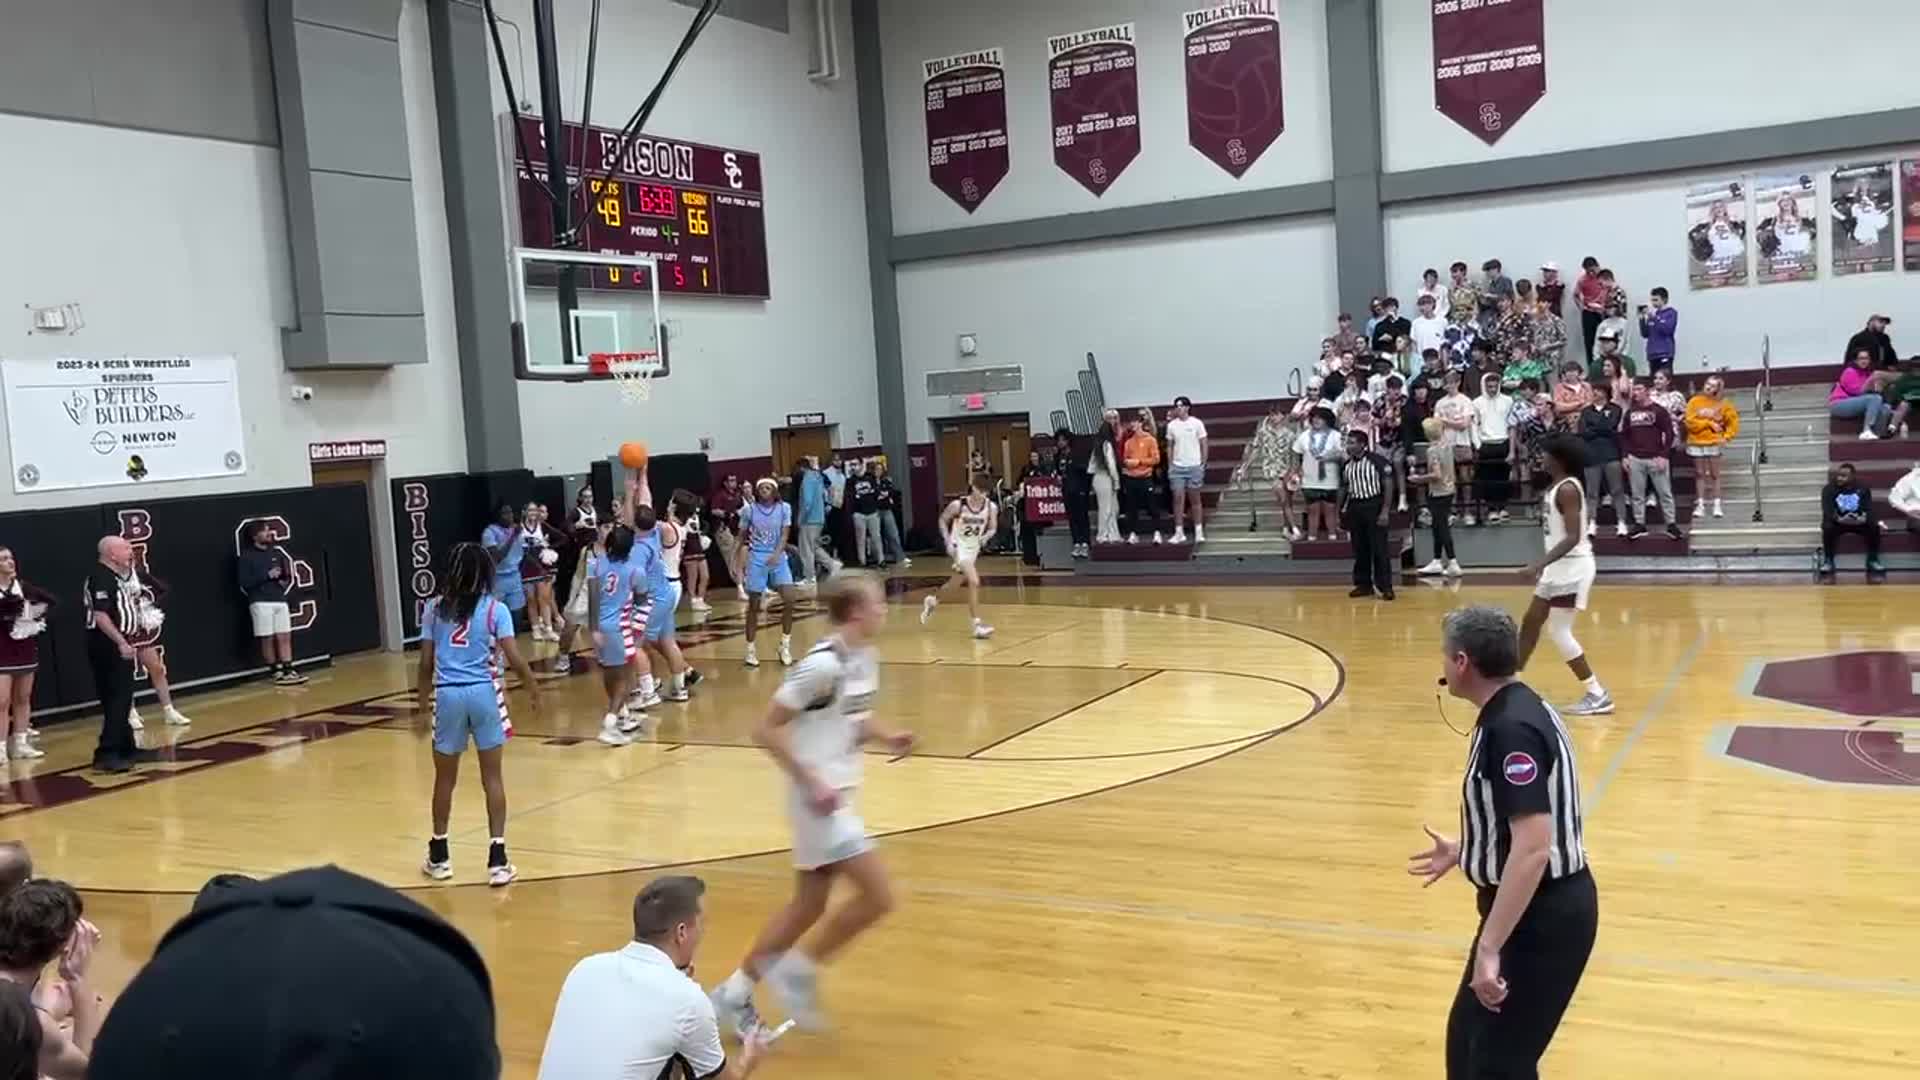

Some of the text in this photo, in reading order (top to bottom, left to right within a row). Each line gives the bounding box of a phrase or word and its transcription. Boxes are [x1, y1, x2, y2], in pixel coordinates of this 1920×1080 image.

[1186, 0, 1274, 29] VOLLEYBALL
[1050, 26, 1132, 53] VOLLEYBALL
[1209, 40, 1230, 53] 2020
[926, 51, 1000, 77] VOLLEYBALL
[1114, 57, 1135, 69] 2020
[1437, 53, 1542, 79] 2006 2007 2008 2009
[984, 79, 1002, 92] 2020
[1116, 115, 1137, 127] 2020
[988, 135, 1007, 148] 2020
[1055, 136, 1074, 147] 2021
[600, 133, 694, 181] BISON
[723, 152, 742, 188] SC
[597, 198, 621, 227] 49
[687, 208, 710, 235] 66
[630, 225, 658, 237] PERIOD
[661, 223, 673, 242] 4
[674, 266, 685, 286] 5
[702, 267, 708, 287] 1
[56, 359, 191, 369] 2023-24 SCHS WRESTLING
[102, 373, 154, 382] SPONSORS
[94, 386, 158, 405] PETTIS
[95, 404, 184, 424] BUILDERS
[122, 431, 177, 443] NEWTON
[311, 442, 385, 458] Girls Locker Room
[1026, 485, 1048, 498] Tribe
[1038, 502, 1066, 514] Sectio
[963, 526, 981, 538] 24
[604, 571, 619, 596] 3
[449, 614, 471, 648] 2
